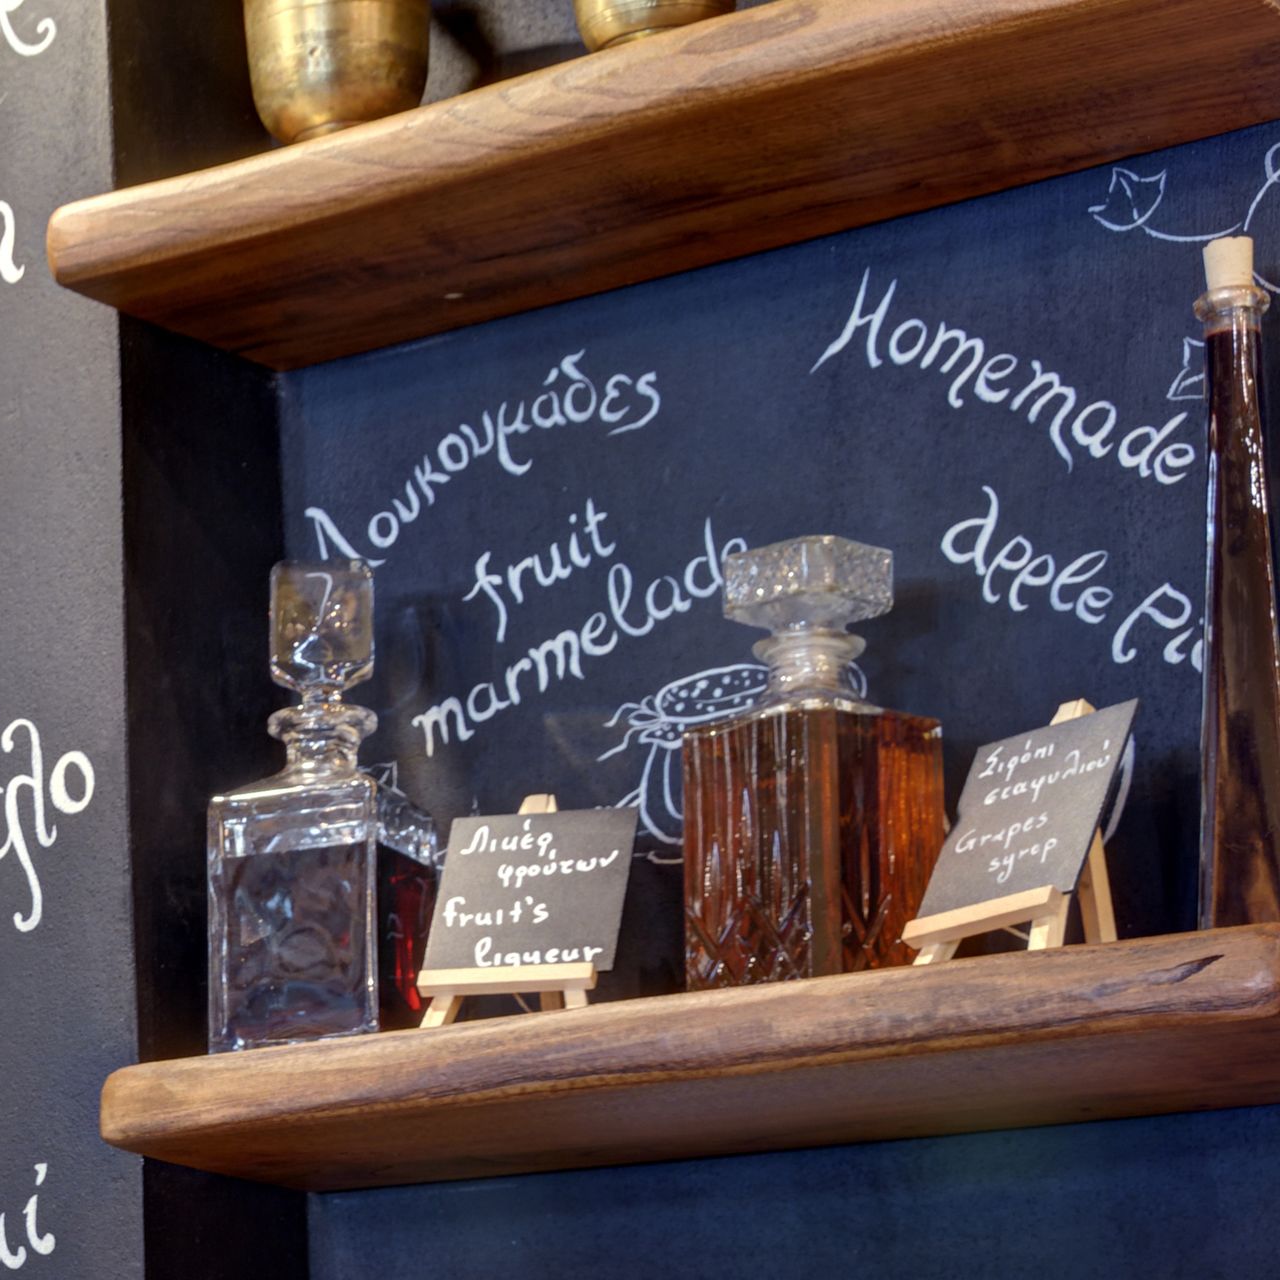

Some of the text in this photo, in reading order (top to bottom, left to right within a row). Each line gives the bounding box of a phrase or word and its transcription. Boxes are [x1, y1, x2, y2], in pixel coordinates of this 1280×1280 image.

[809, 265, 1196, 485] Homemade
[304, 348, 662, 568] Λουκουμάδες
[463, 498, 617, 642] fruit
[954, 811, 1049, 854] Grapes
[497, 848, 619, 889] φρούτων
[442, 895, 550, 928] fruit's
[473, 936, 604, 968] liqueur
